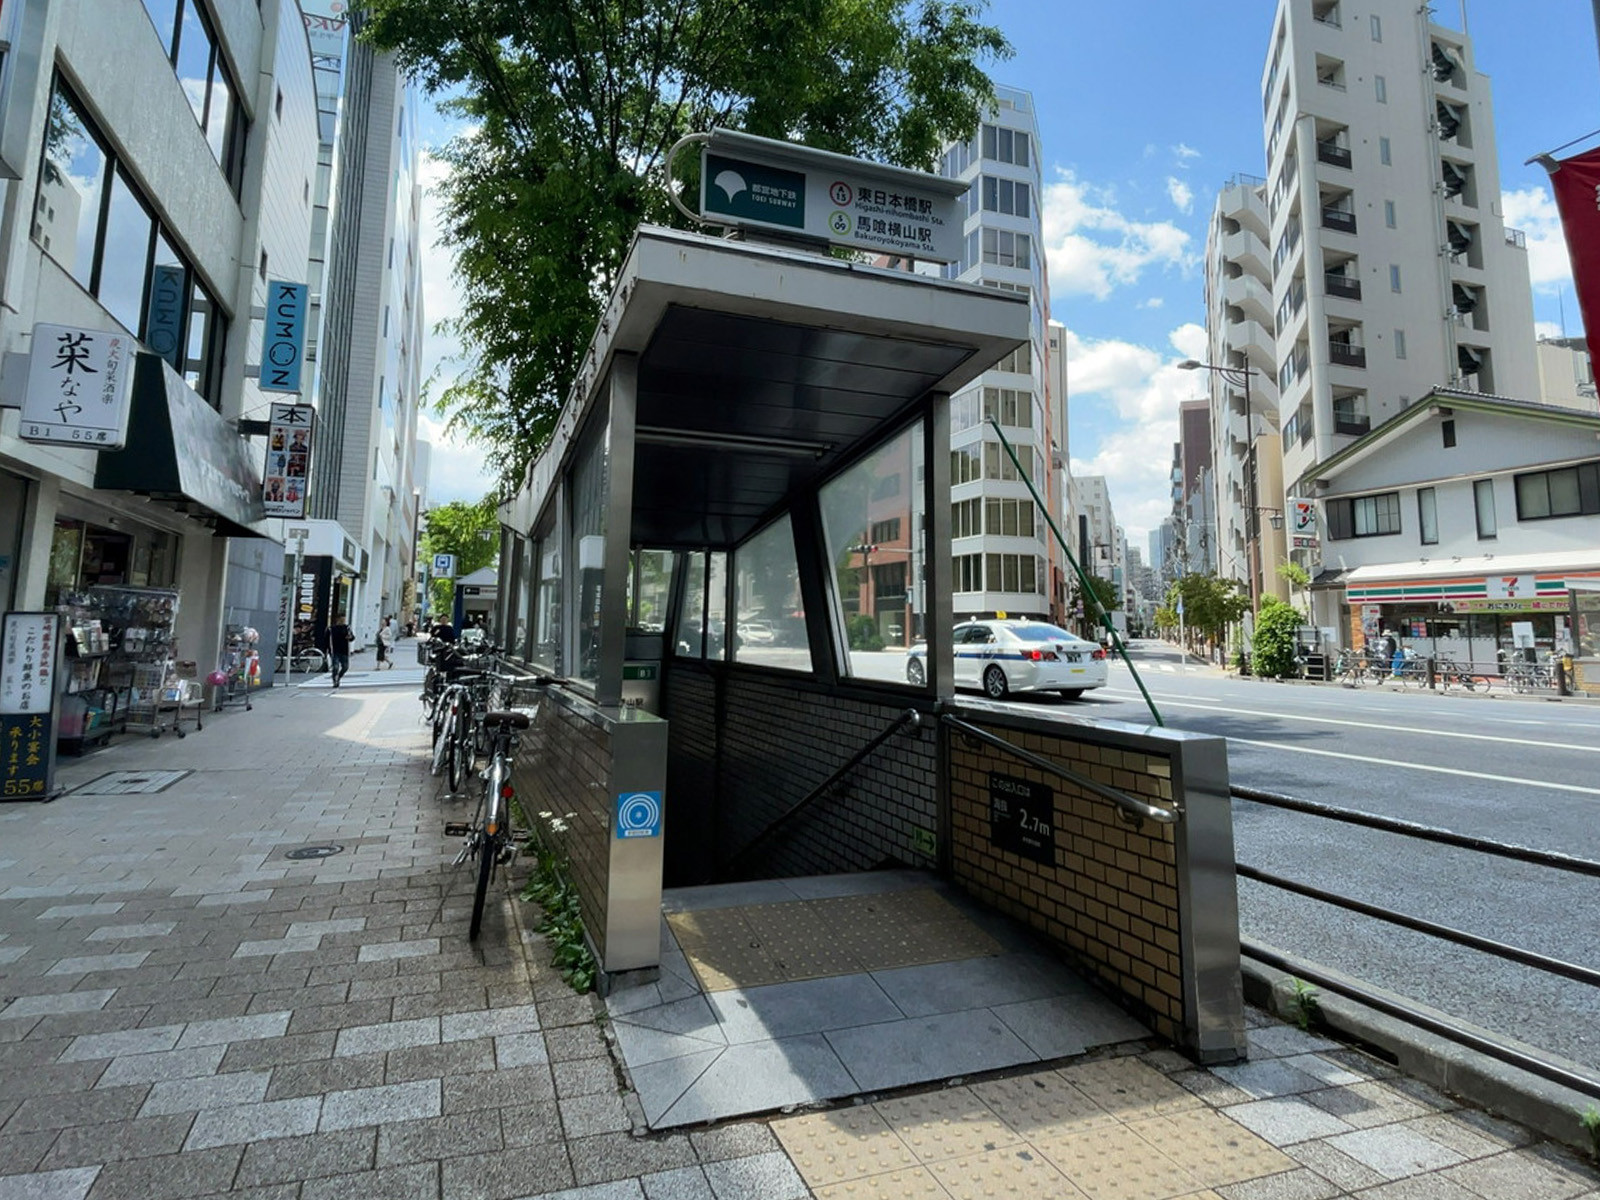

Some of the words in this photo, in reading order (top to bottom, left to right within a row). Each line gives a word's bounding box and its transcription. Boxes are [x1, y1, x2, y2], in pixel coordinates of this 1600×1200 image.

[751, 183, 797, 200] 都営地下鉄
[836, 193, 846, 201] 15
[857, 187, 932, 215] 東日本橋駅
[854, 202, 930, 223] Higashi-nihombashi
[930, 216, 945, 226] Sta.
[834, 222, 846, 231] 09
[857, 216, 932, 243] 馬喰横山駅
[854, 231, 920, 249] Bakuroyokoyama
[921, 242, 936, 252] Sta.
[269, 286, 297, 386] KUMON
[50, 332, 98, 423] 菜なや
[277, 407, 307, 424] 本
[29, 426, 51, 437] B1
[71, 429, 108, 441] 55席
[19, 626, 36, 710] こだわり鮮魚のお店
[7, 726, 23, 777] 承ります
[26, 715, 43, 766] 大小宴会
[3, 778, 45, 795] 55席
[1019, 808, 1050, 836] 2.7m
